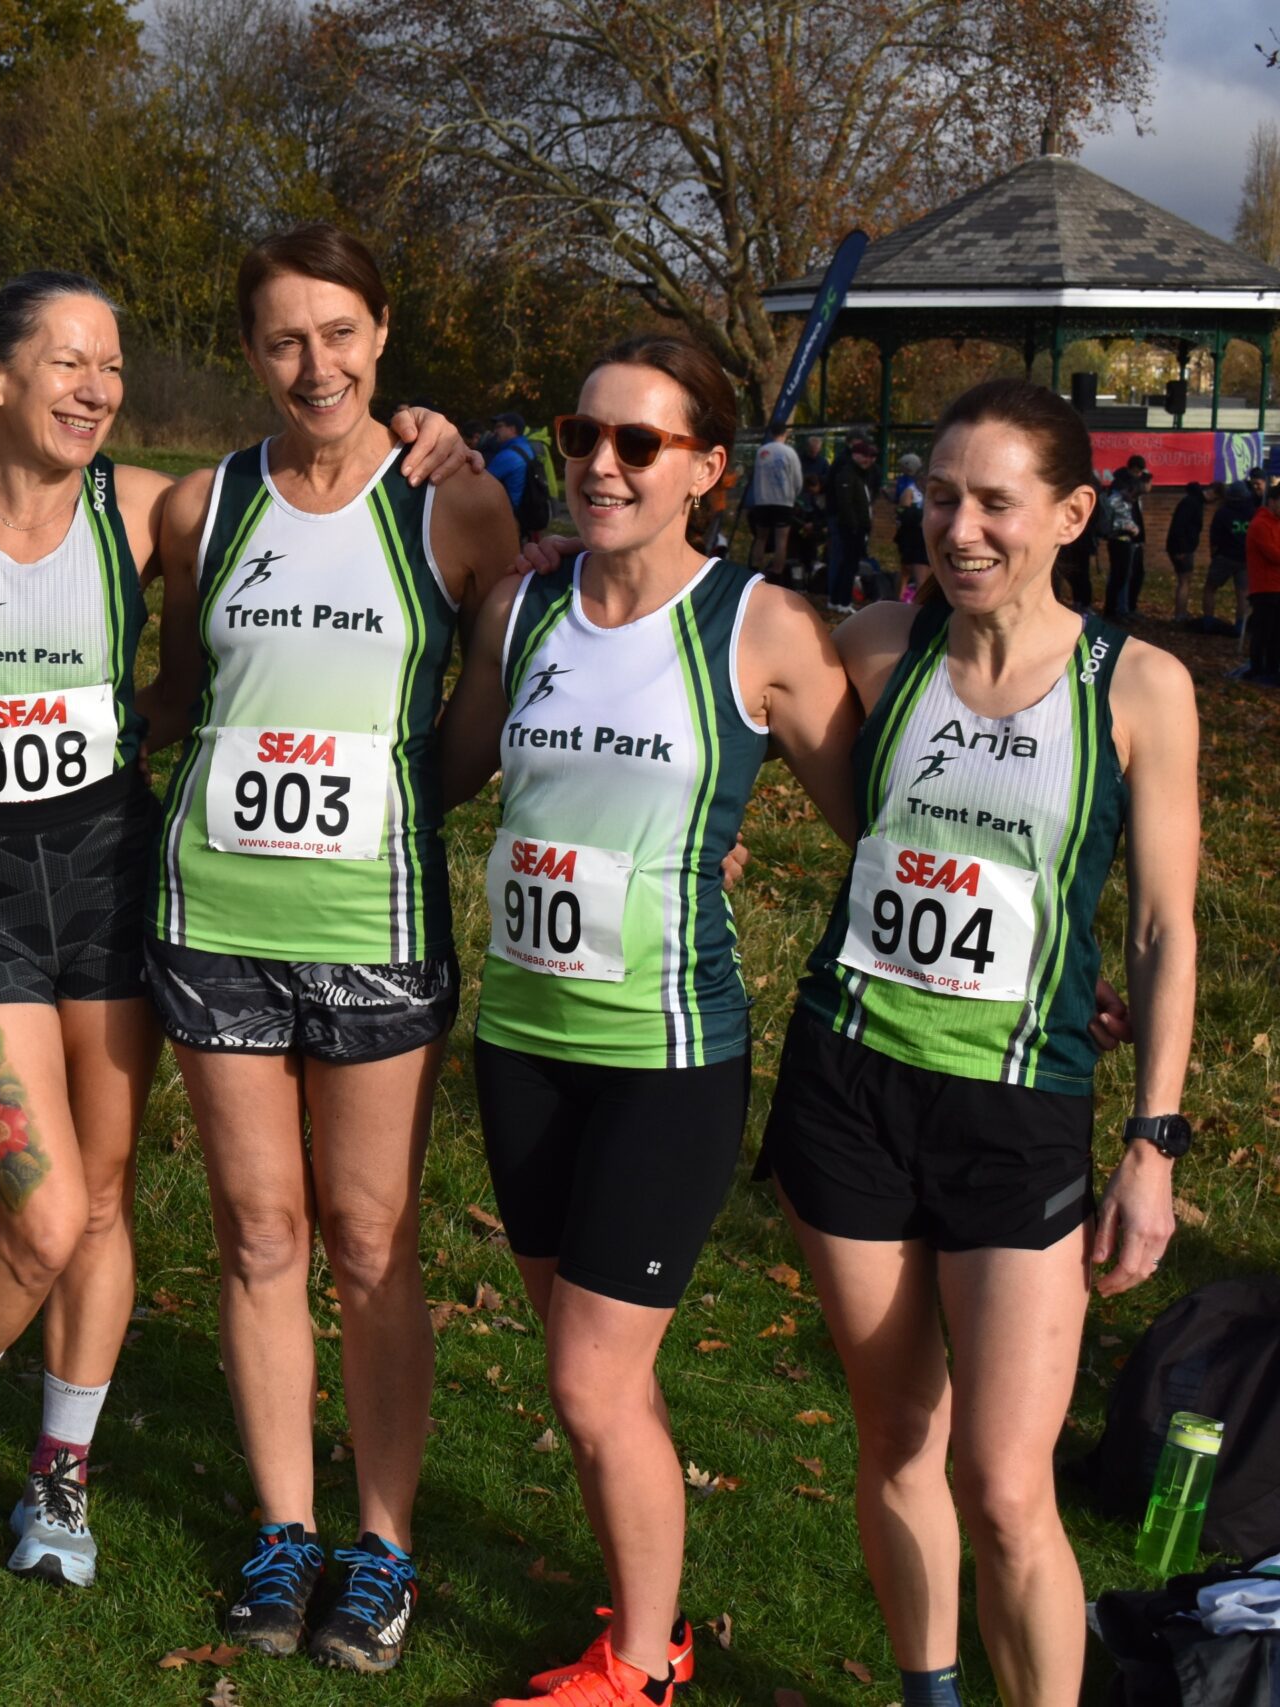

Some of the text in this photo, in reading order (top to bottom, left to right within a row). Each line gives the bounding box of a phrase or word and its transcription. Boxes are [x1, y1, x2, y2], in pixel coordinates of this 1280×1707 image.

[93, 468, 107, 514] soar
[225, 604, 384, 634] Trent Park
[34, 648, 84, 665] Park
[1079, 636, 1110, 686] soar
[257, 731, 337, 767] SEAA
[508, 722, 674, 763] Trent Park
[929, 719, 1038, 760] Anja
[234, 770, 351, 837] 903
[907, 797, 1034, 838] Trent Park
[238, 837, 342, 855] www.seaa.org.uk
[510, 839, 577, 883] SEAA
[895, 850, 981, 897] SEAA
[505, 879, 581, 954] 910
[871, 889, 995, 974] 904
[505, 945, 585, 972] www.seaa.org.uk
[873, 958, 981, 992] www.seaa.org.uk
